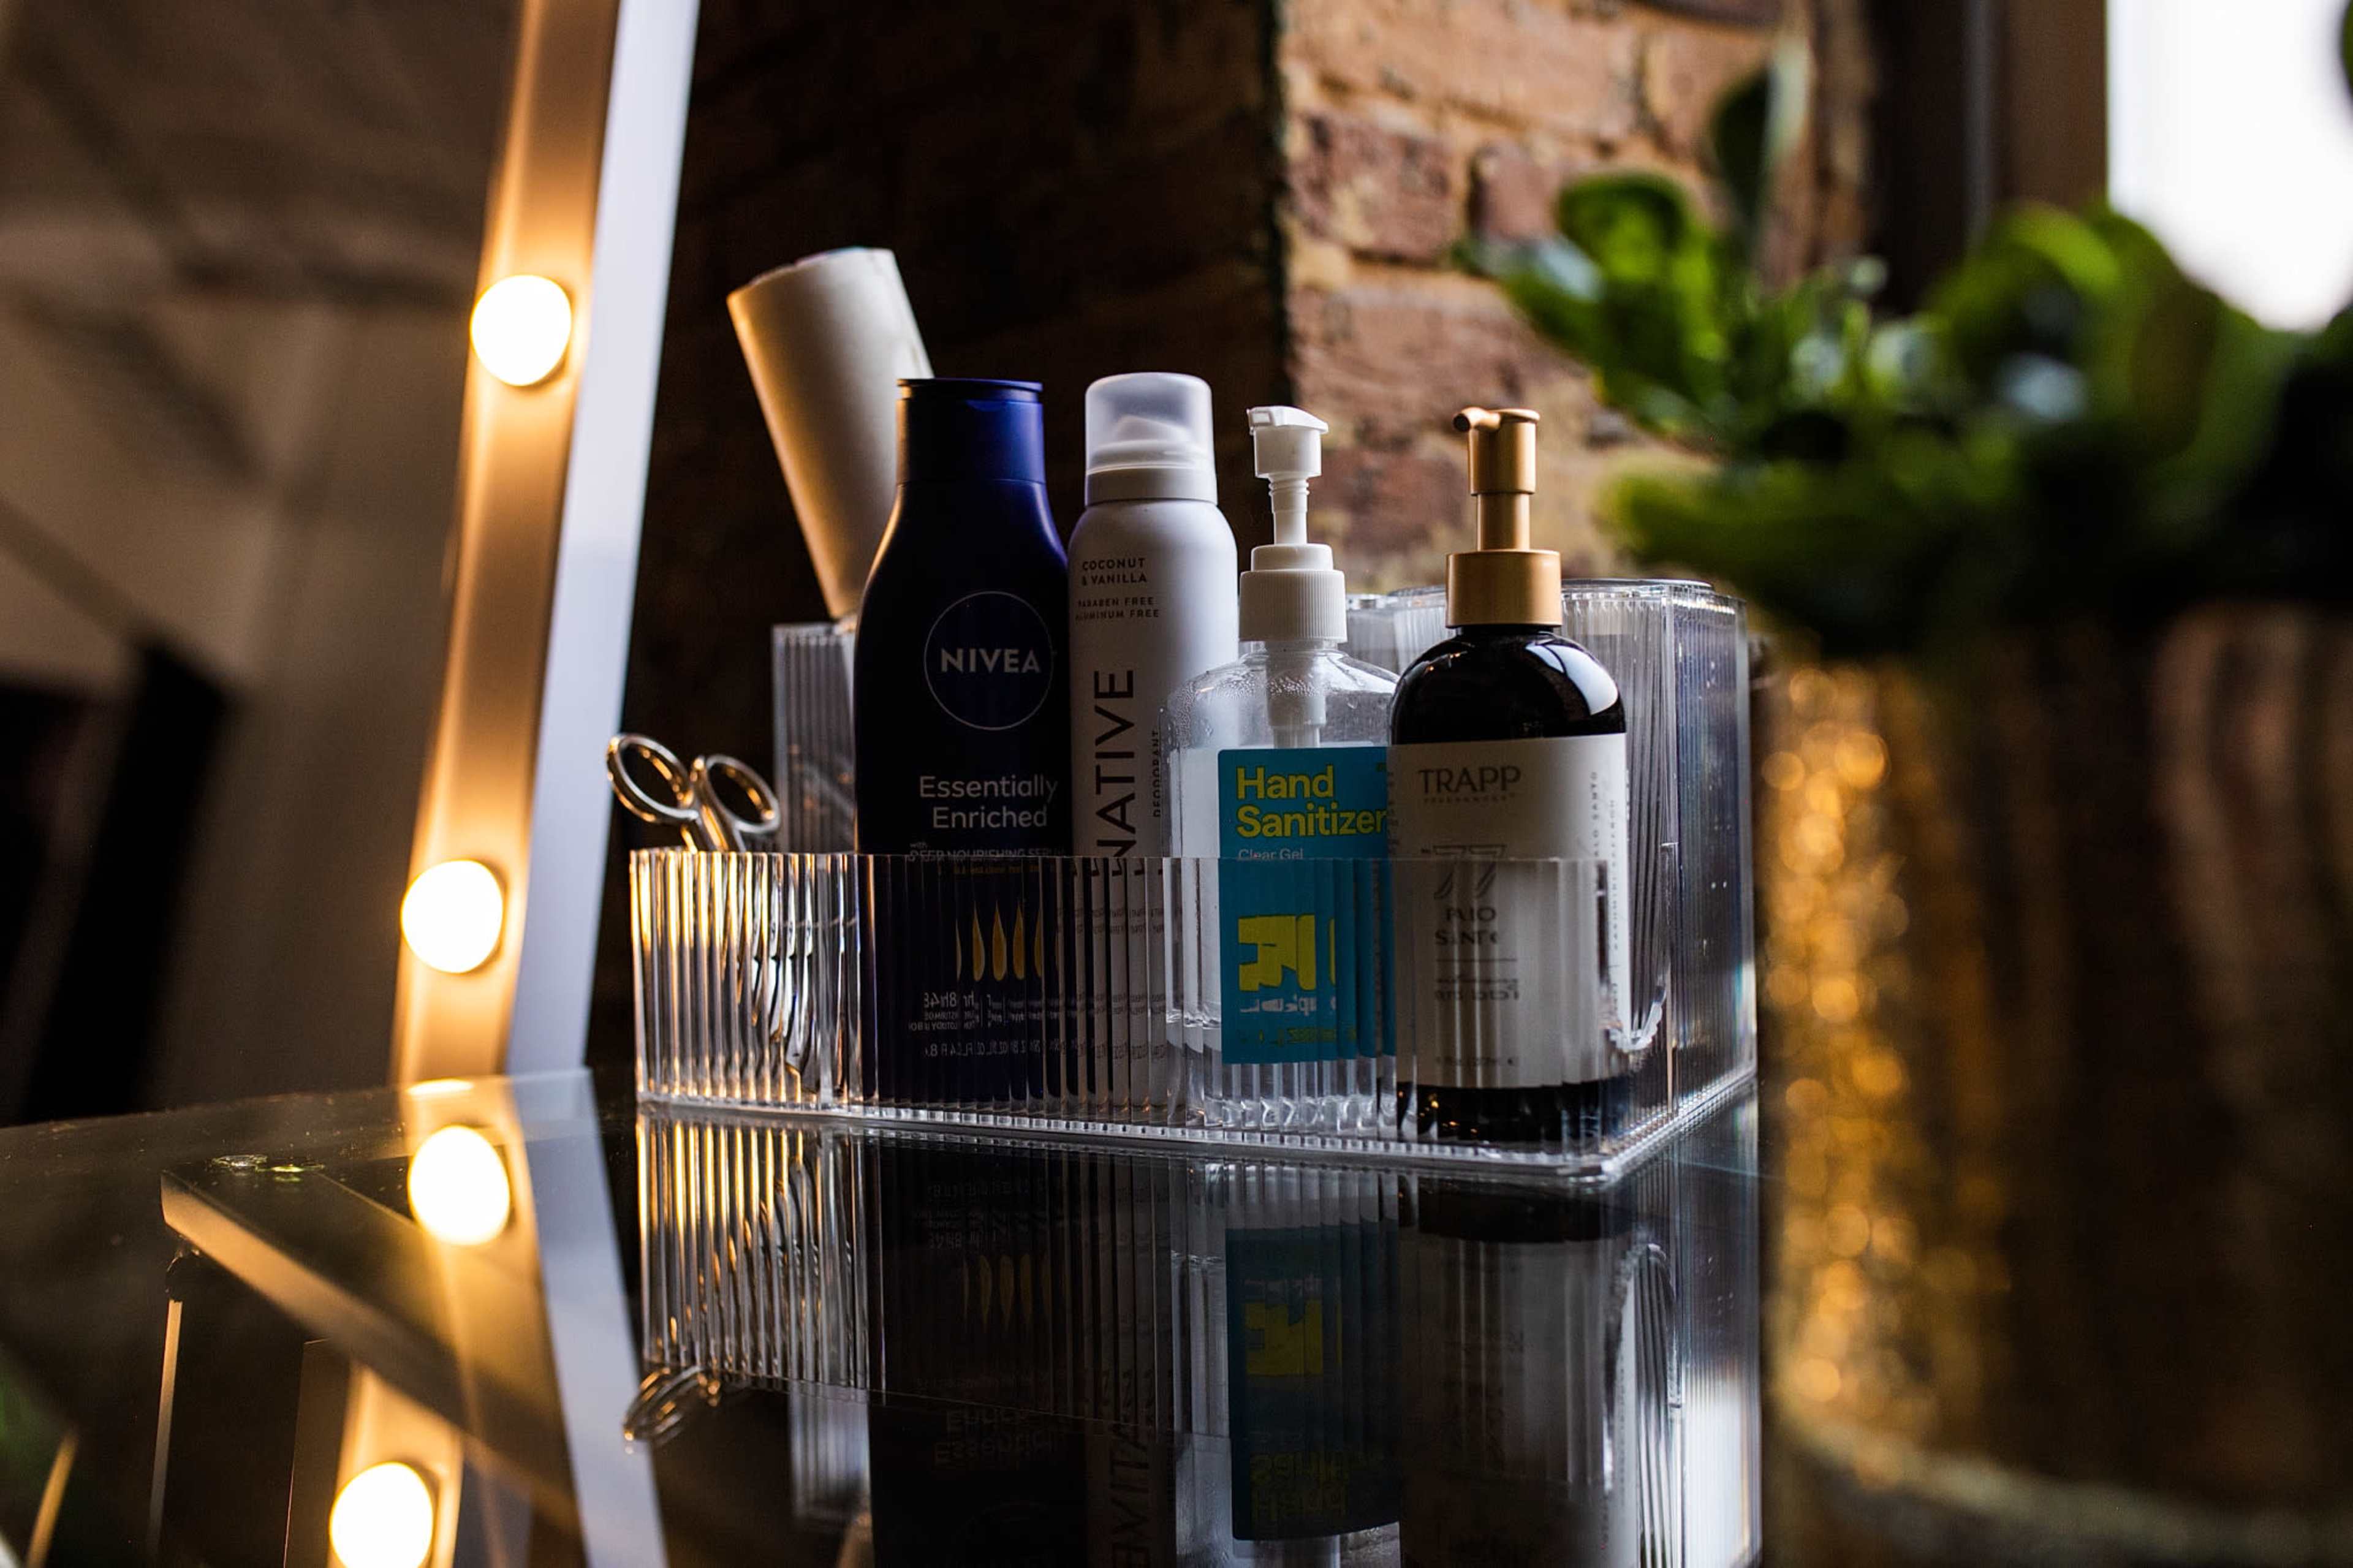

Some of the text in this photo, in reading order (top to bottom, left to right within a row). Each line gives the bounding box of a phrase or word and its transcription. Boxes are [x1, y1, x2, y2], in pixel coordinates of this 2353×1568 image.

[1082, 558, 1145, 571] COCONUT
[1091, 574, 1146, 585] VANILLA
[1124, 597, 1154, 605] FREE
[1130, 609, 1159, 618] FREE
[941, 648, 1041, 673] NIVEA
[1152, 730, 1161, 817] DEODORANT
[1237, 765, 1334, 799] Hand
[1419, 766, 1521, 793] TRAPP
[920, 775, 1058, 803] Essentially
[933, 806, 1047, 828] Enriched
[1237, 801, 1387, 838] Sanitizer
[1238, 848, 1303, 861] Clear Gel
